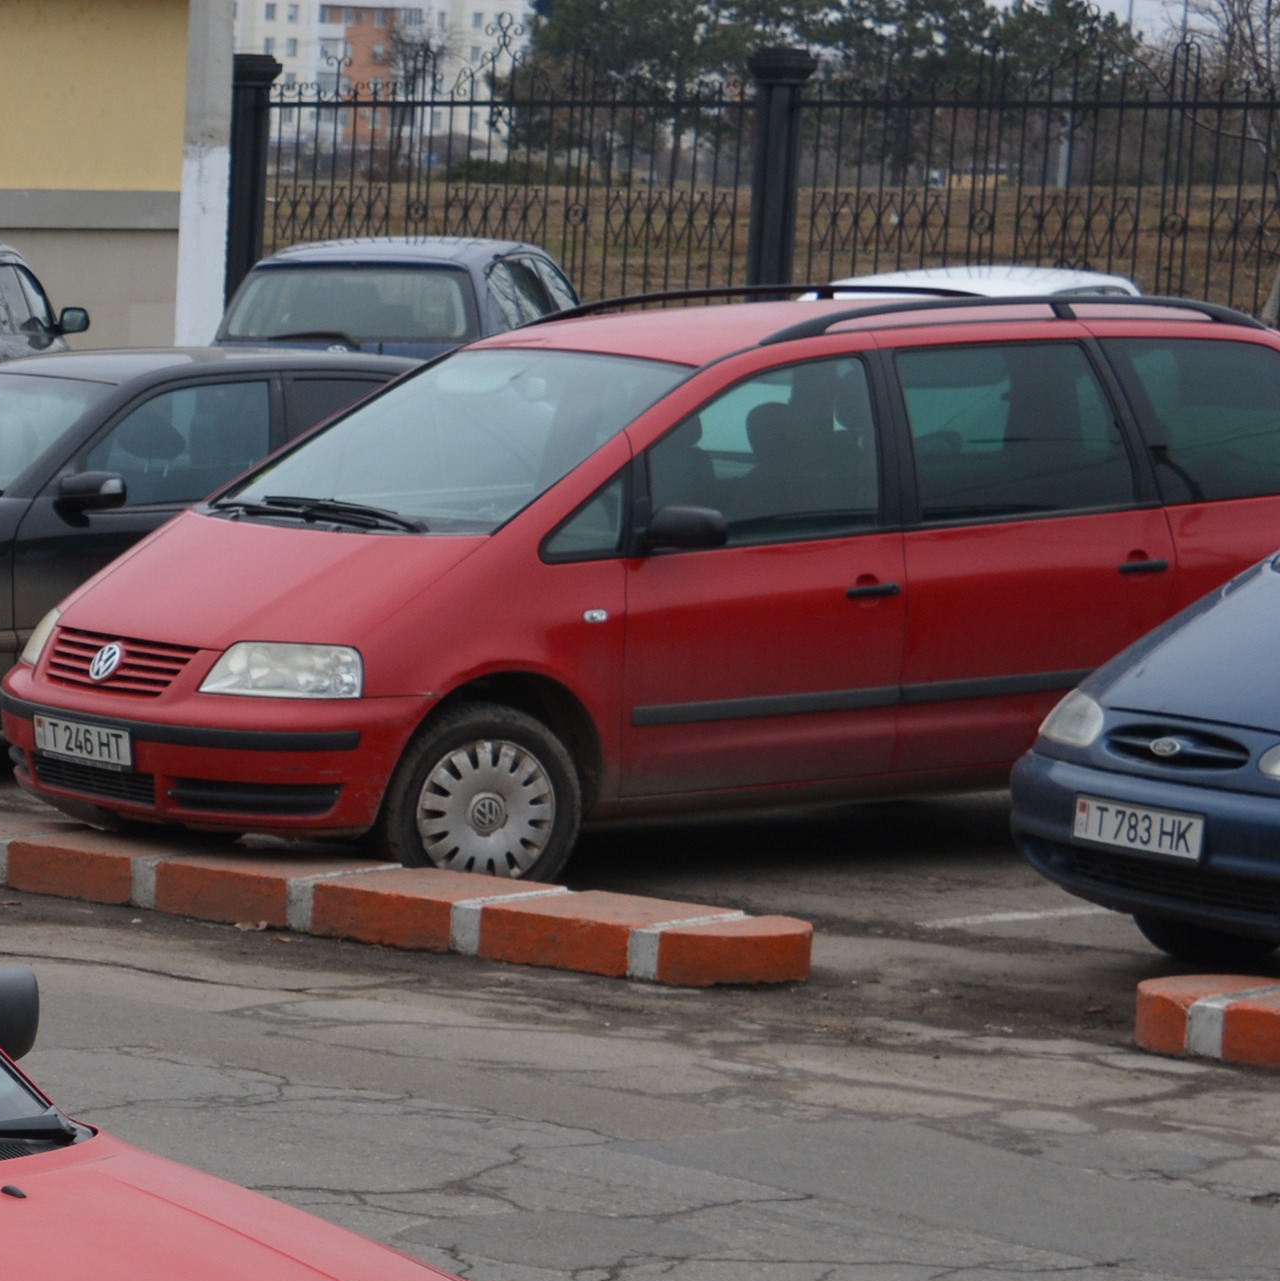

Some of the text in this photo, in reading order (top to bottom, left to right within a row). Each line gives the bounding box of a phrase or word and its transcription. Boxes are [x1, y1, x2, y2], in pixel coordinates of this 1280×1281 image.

[48, 721, 59, 748] T
[63, 725, 94, 755] 246
[96, 730, 124, 761] HT
[1095, 805, 1194, 854] T 783 HK
